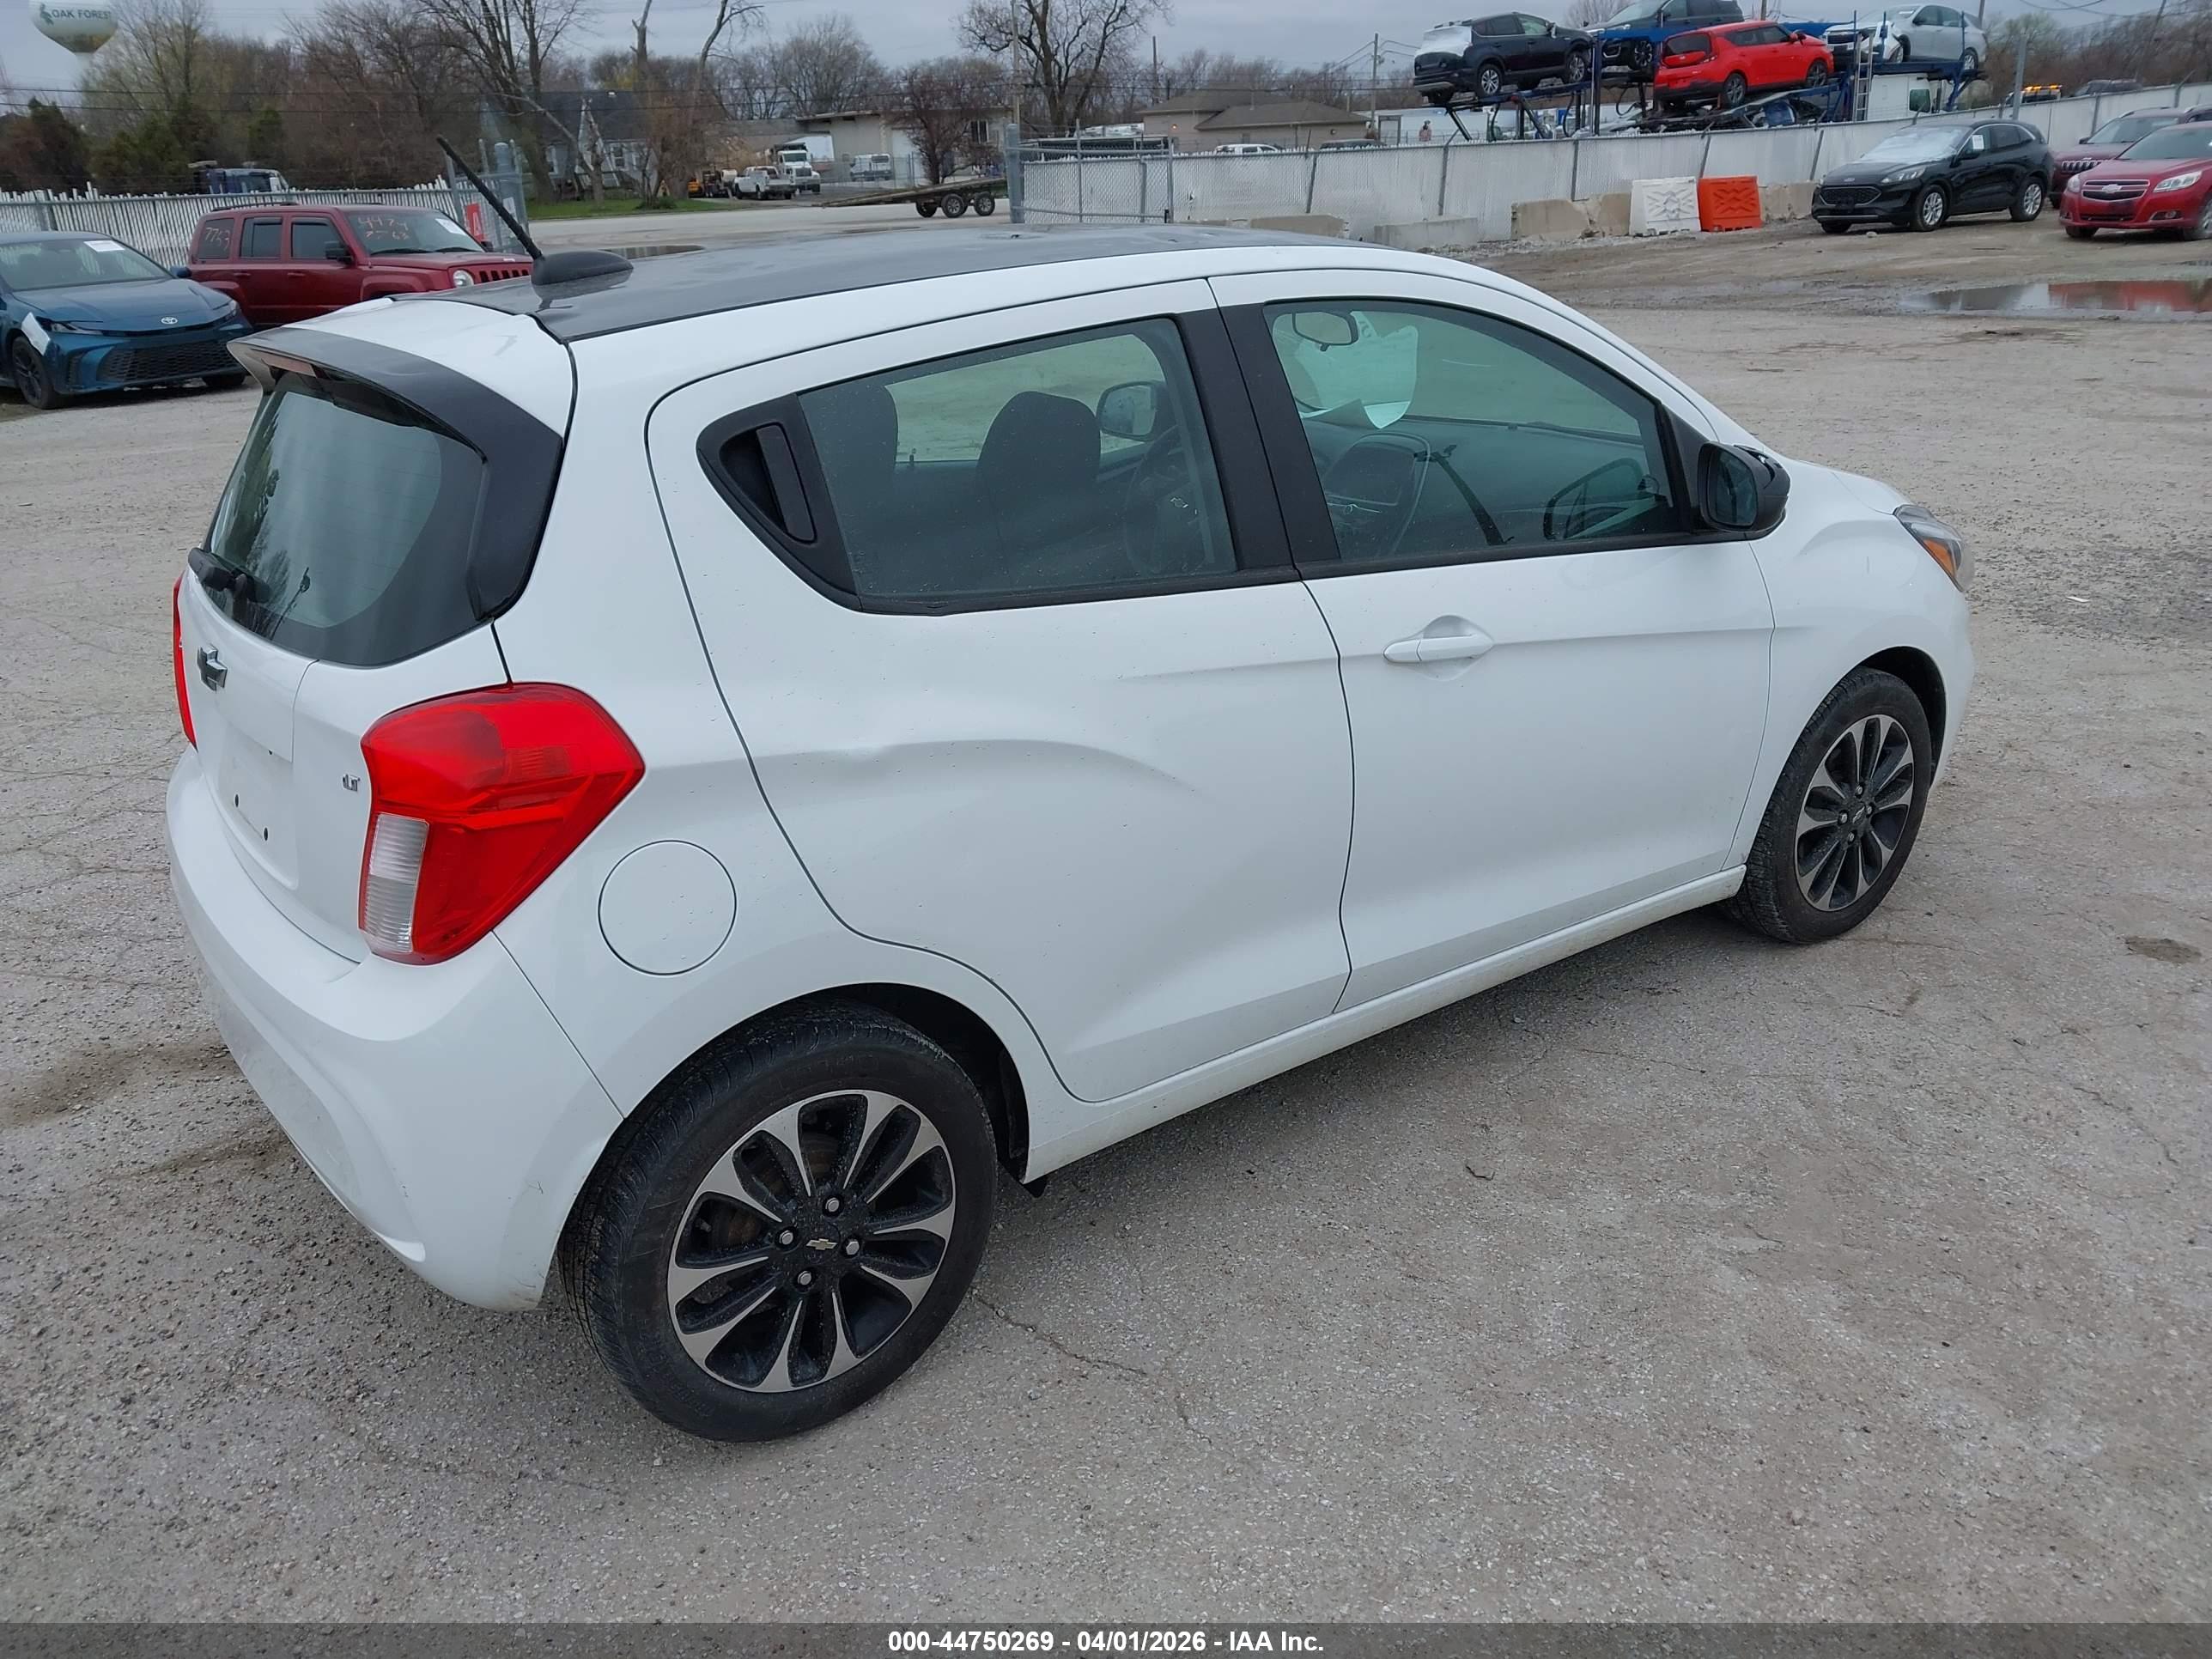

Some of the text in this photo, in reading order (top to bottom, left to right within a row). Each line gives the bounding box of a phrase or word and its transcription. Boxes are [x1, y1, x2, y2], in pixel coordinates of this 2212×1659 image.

[52, 9, 111, 20] OAK FOREST
[342, 774, 361, 793] LT
